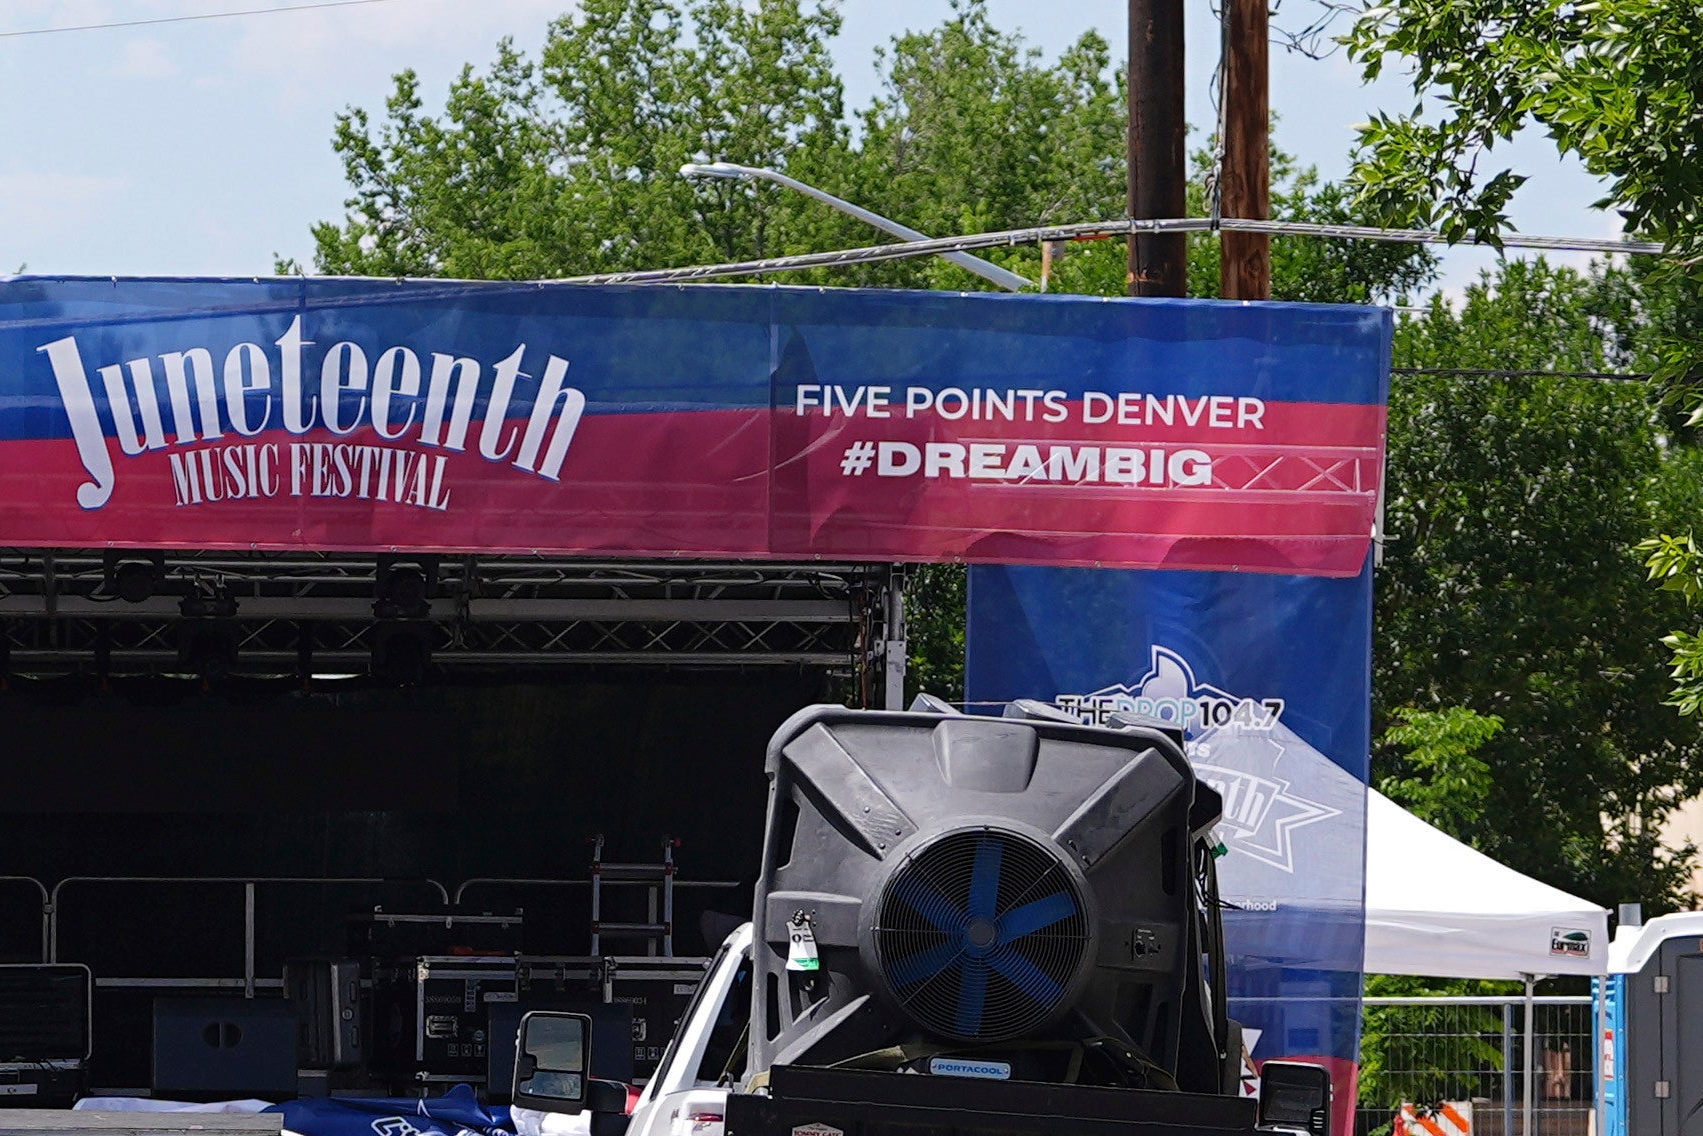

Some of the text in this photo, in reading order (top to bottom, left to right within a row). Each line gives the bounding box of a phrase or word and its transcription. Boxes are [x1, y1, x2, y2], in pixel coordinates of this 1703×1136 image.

[37, 315, 586, 511] Juneteenth
[797, 384, 1266, 430] FIVE POINTS DENVER
[169, 442, 452, 511] MUSIC FESTIVAL
[840, 440, 1213, 487] #DREAMBIG
[937, 1062, 1004, 1076] PORTACOOL
